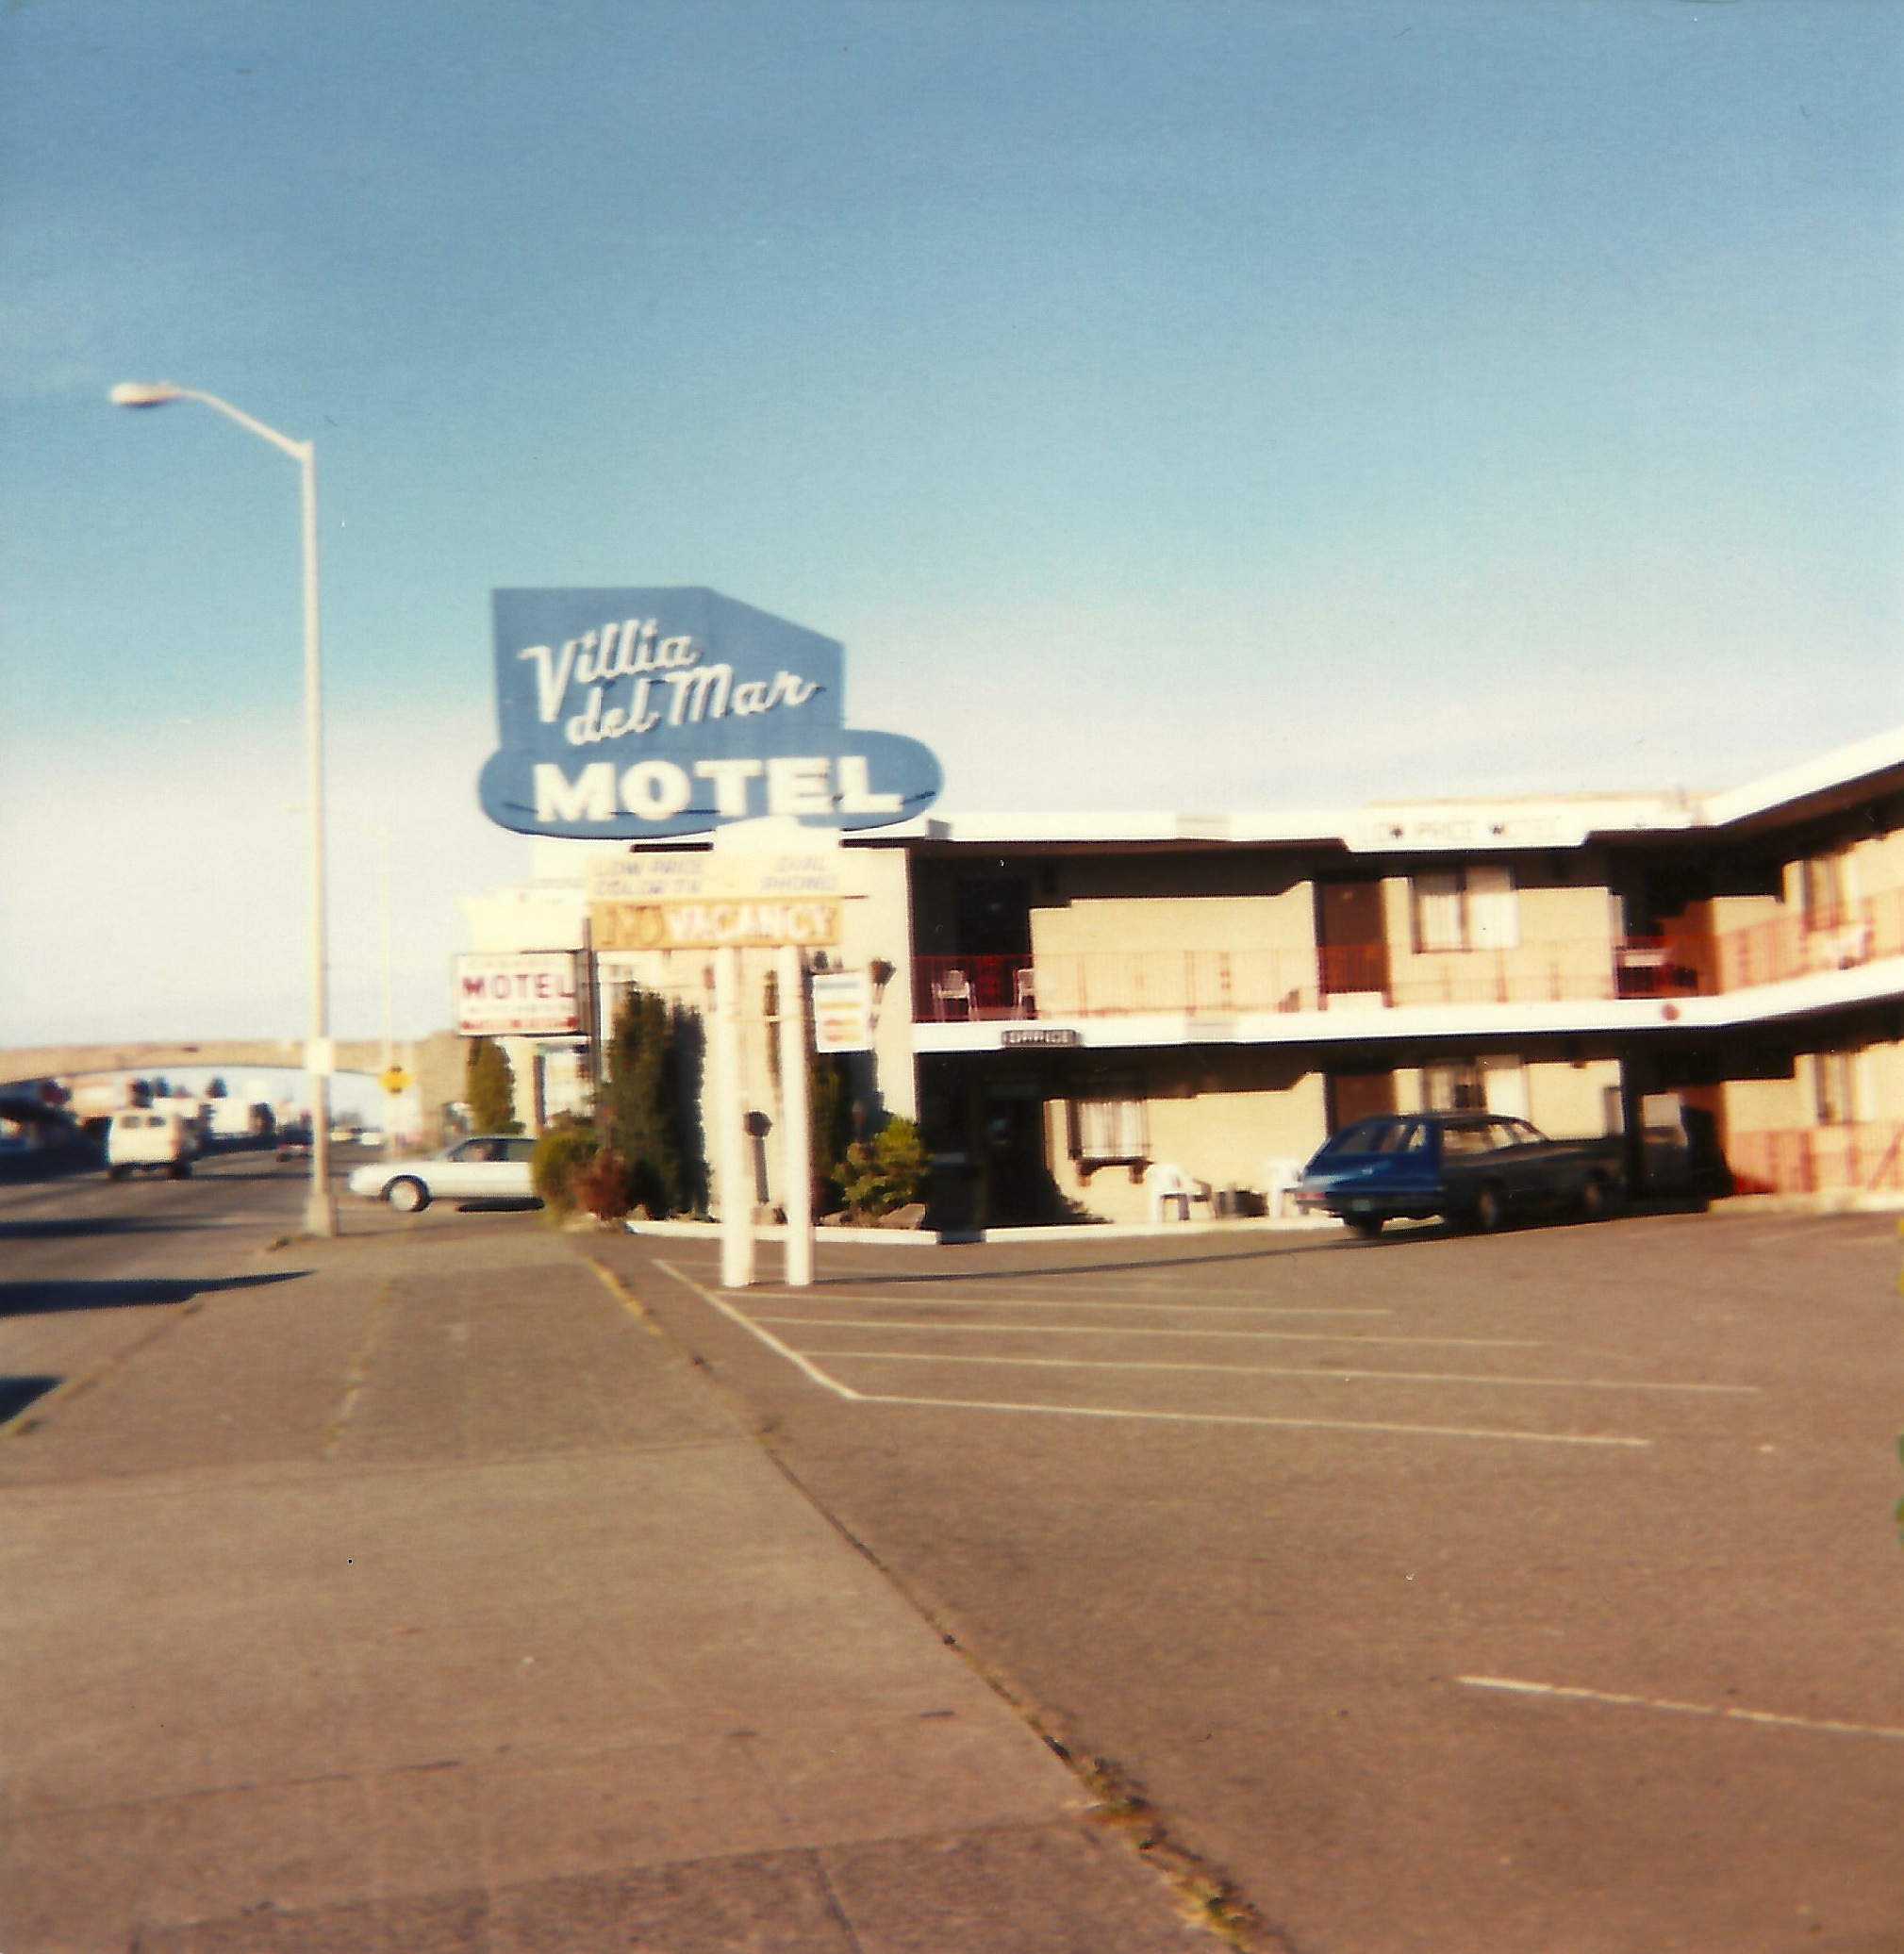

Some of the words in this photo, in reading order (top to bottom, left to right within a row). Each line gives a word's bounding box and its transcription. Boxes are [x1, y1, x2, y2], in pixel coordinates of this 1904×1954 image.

[519, 619, 703, 723] Villia
[566, 678, 660, 746] del
[664, 663, 820, 726] Mar
[534, 757, 902, 823] MOTEL
[667, 902, 836, 943] VACANCY
[460, 971, 576, 1001] MOTEL
